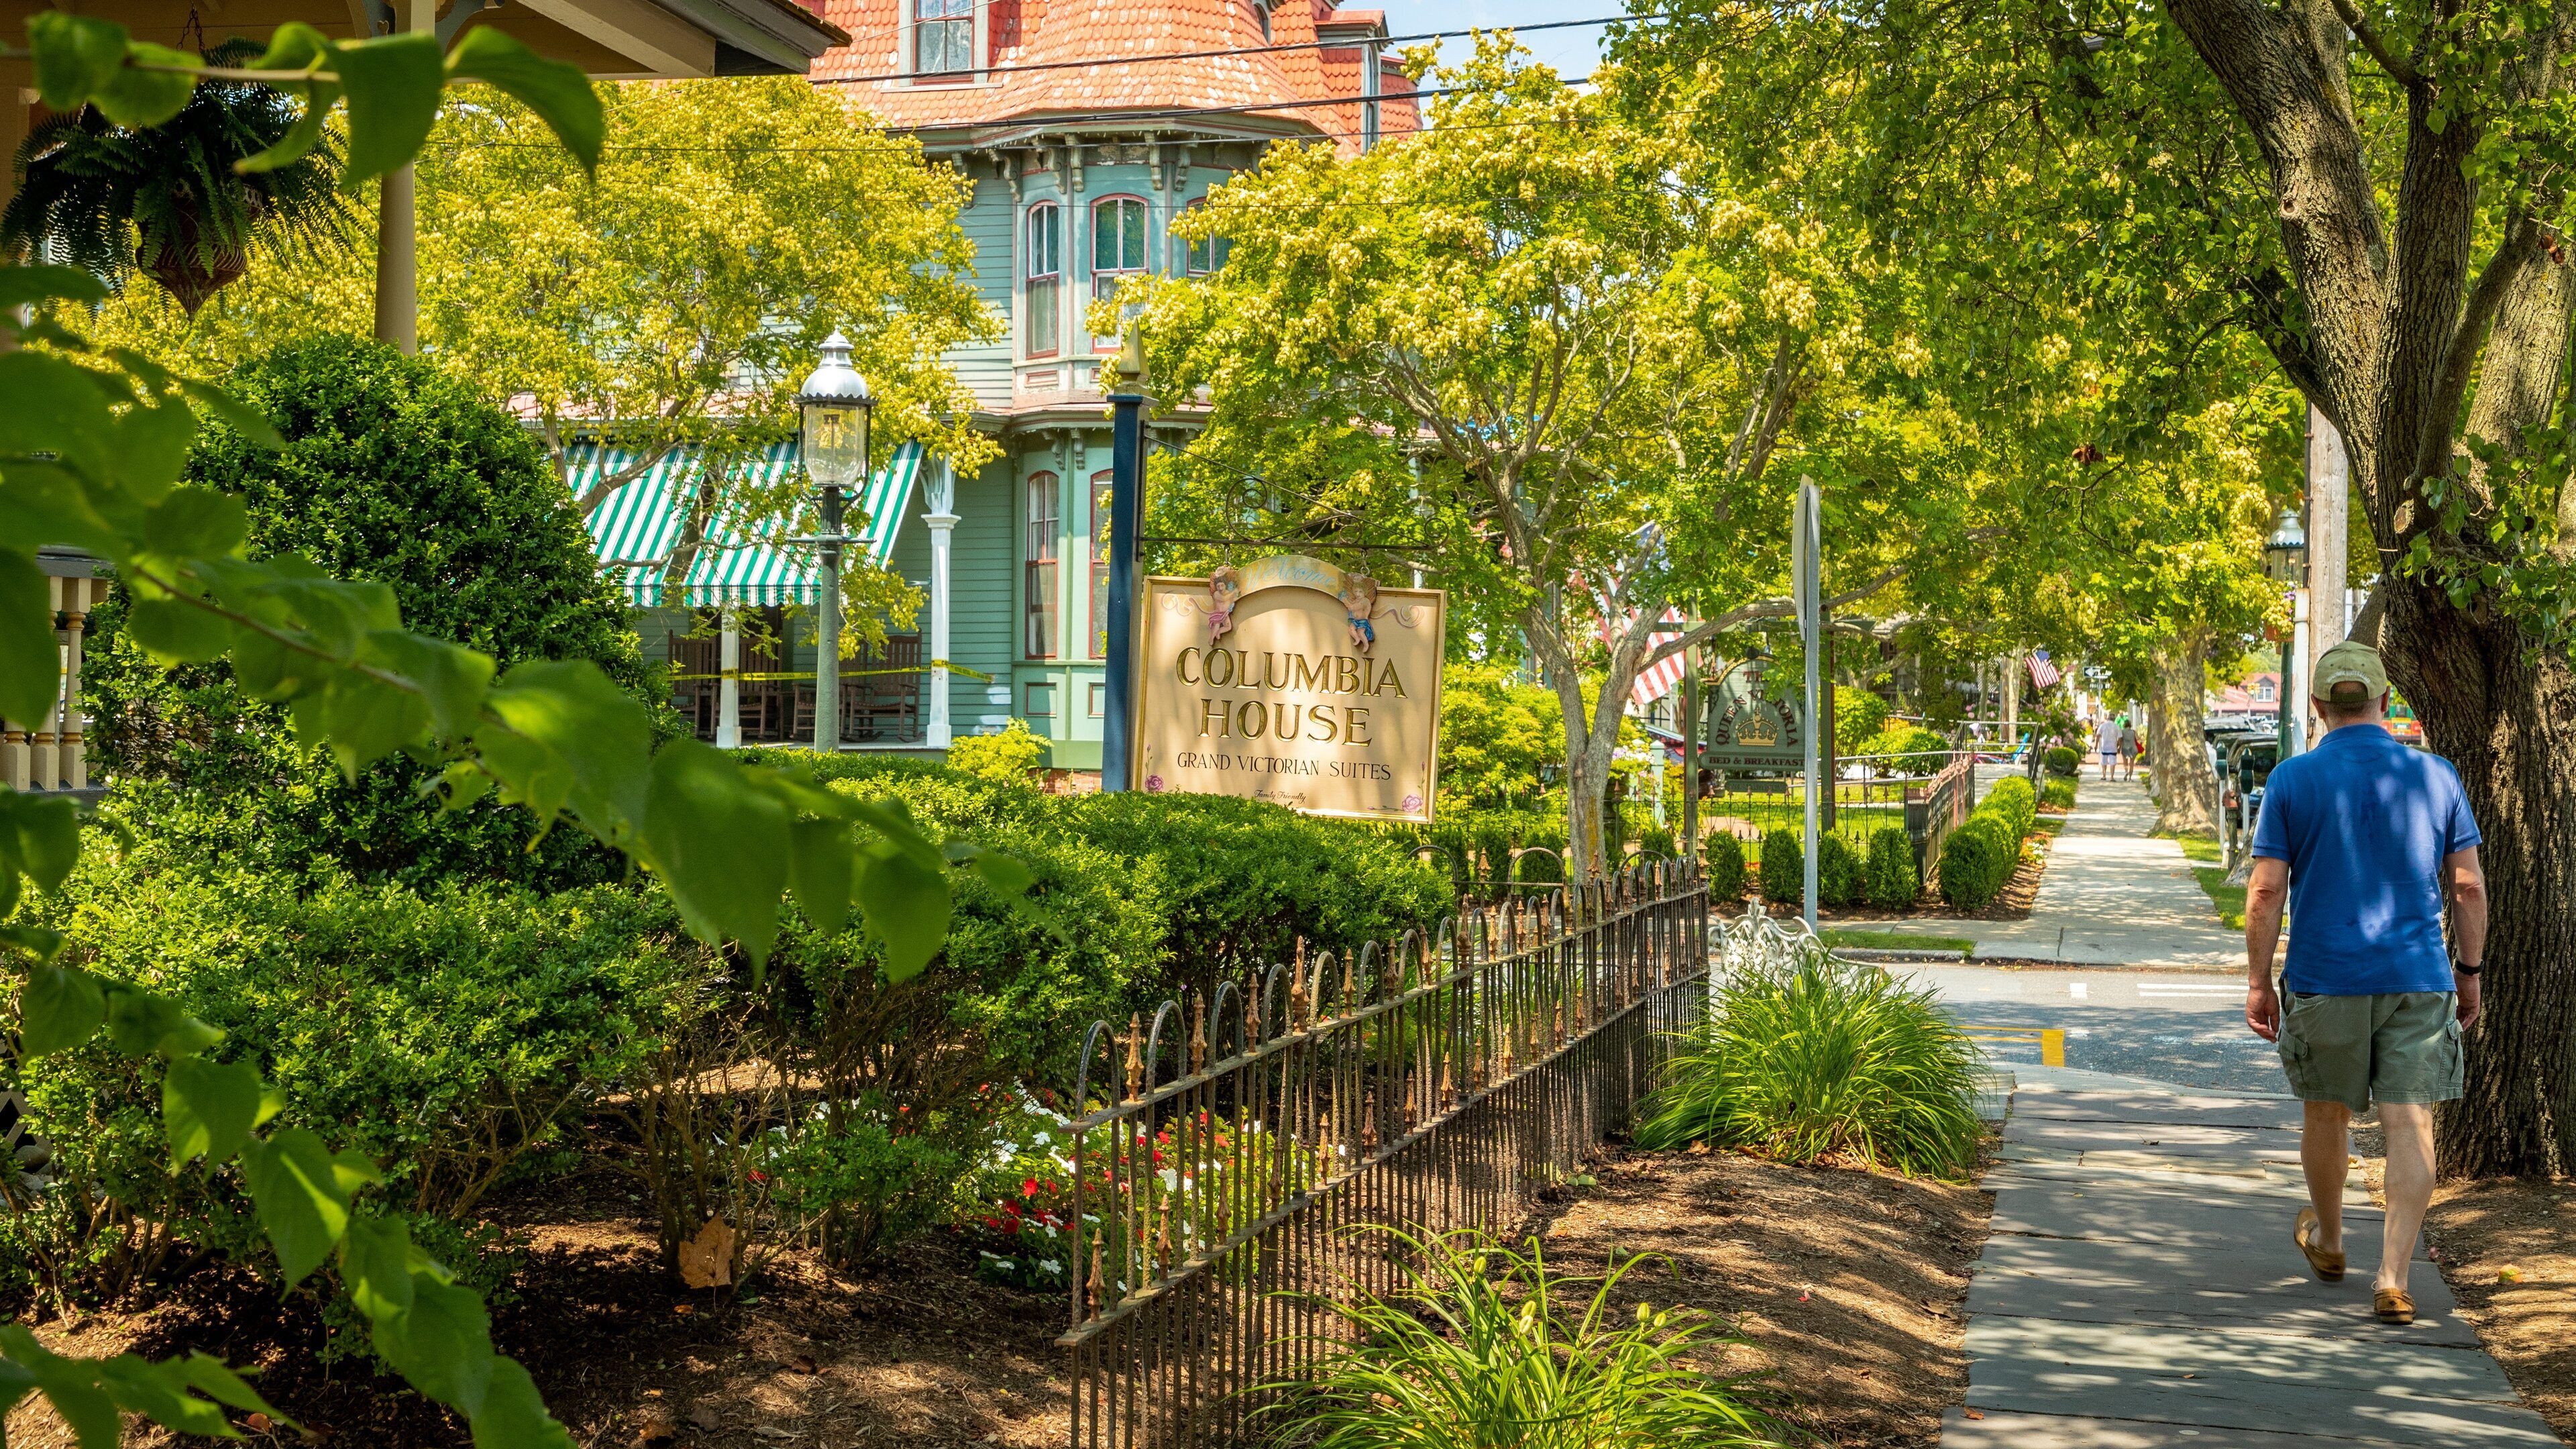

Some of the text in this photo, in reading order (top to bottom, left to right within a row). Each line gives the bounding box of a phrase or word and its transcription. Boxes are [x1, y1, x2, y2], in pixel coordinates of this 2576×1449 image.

[1242, 556, 1337, 591] Welcome
[1176, 647, 1408, 699] COLUMBIA
[1198, 698, 1373, 747] HOUSE
[1715, 688, 1798, 747] QUEEN VITORIA
[1177, 752, 1391, 780] GRAND VICTORIAN SUITES
[1744, 757, 1805, 766] BREAKFAST
[1254, 789, 1307, 804] Family Friendly
